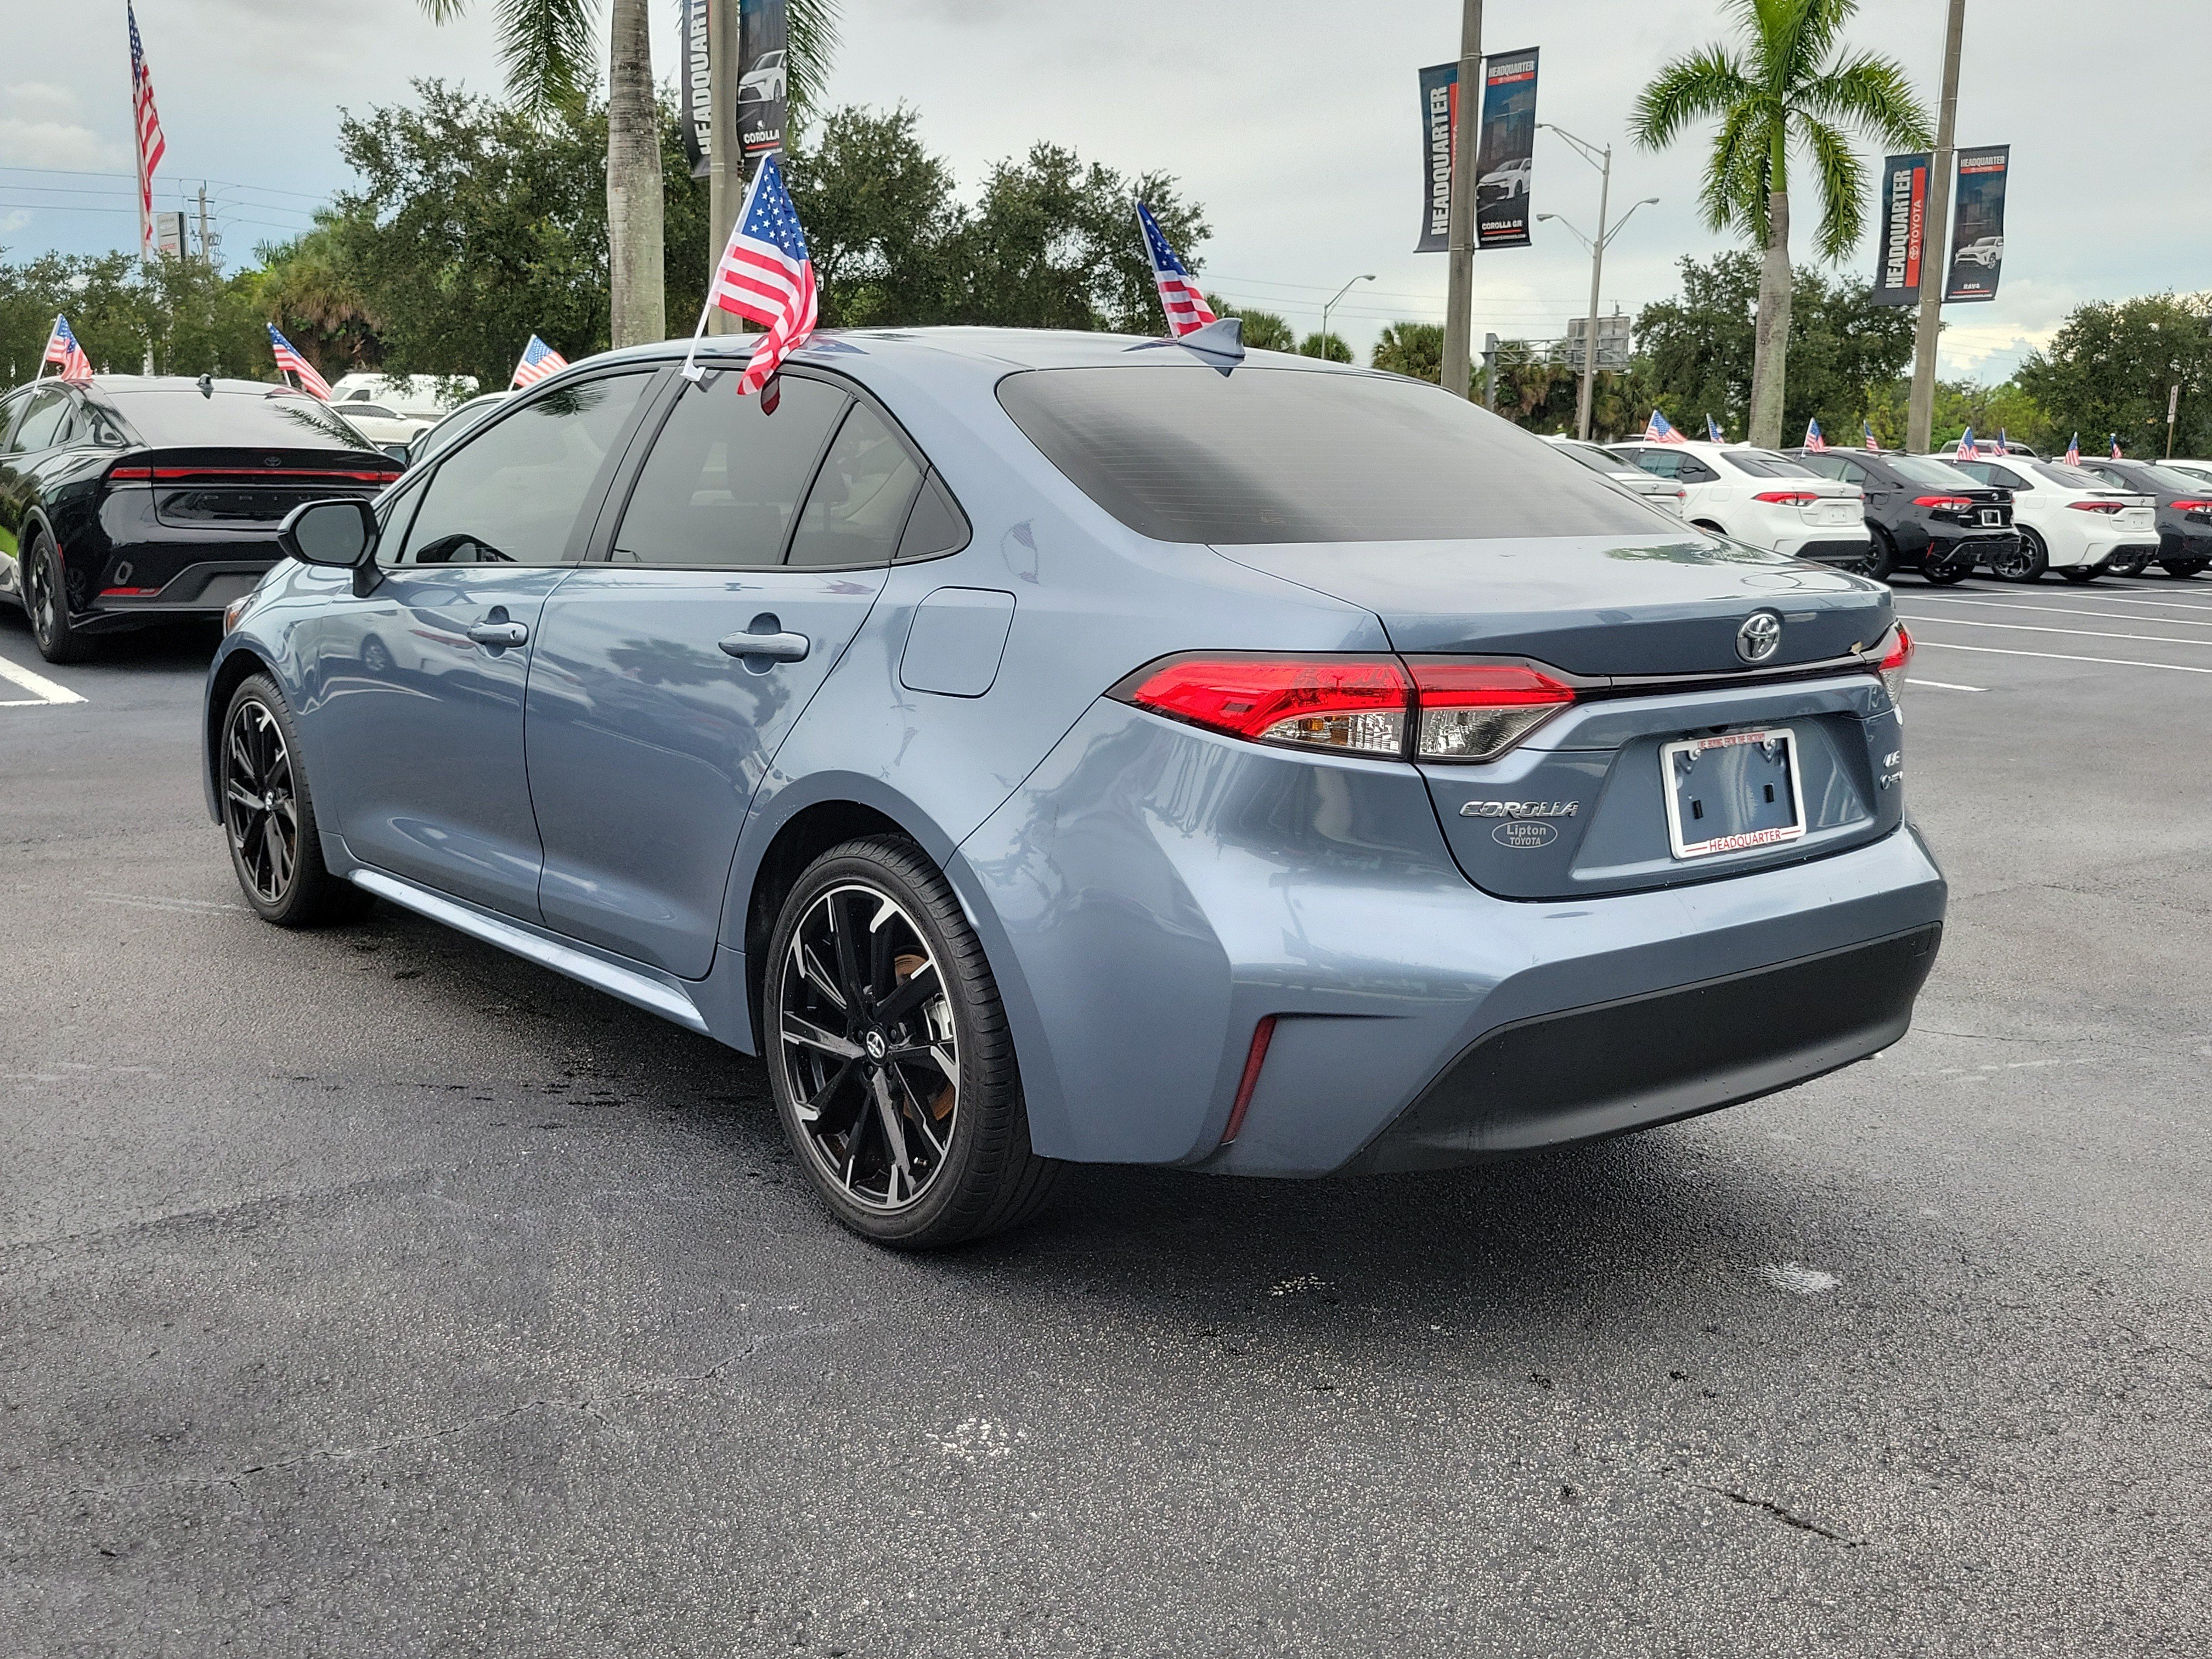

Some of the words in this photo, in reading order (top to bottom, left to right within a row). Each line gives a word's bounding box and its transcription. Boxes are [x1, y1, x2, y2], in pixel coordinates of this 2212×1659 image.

[691, 0, 712, 155] HEADQUART
[1488, 60, 1534, 78] HEADQUARTER
[743, 129, 780, 144] COROLLA
[1430, 86, 1452, 235] HEADQUARTER
[1961, 156, 2005, 167] HEADQUARTER
[1482, 221, 1512, 230] COROLLA
[1885, 170, 1911, 289] HEADQUARTER
[1910, 199, 1922, 245] TOYOTA
[1459, 800, 1581, 819] COROLLA
[1506, 825, 1547, 837] Lipton
[1510, 837, 1541, 845] TOYOTA
[1709, 830, 1781, 851] HEADQUARTER
